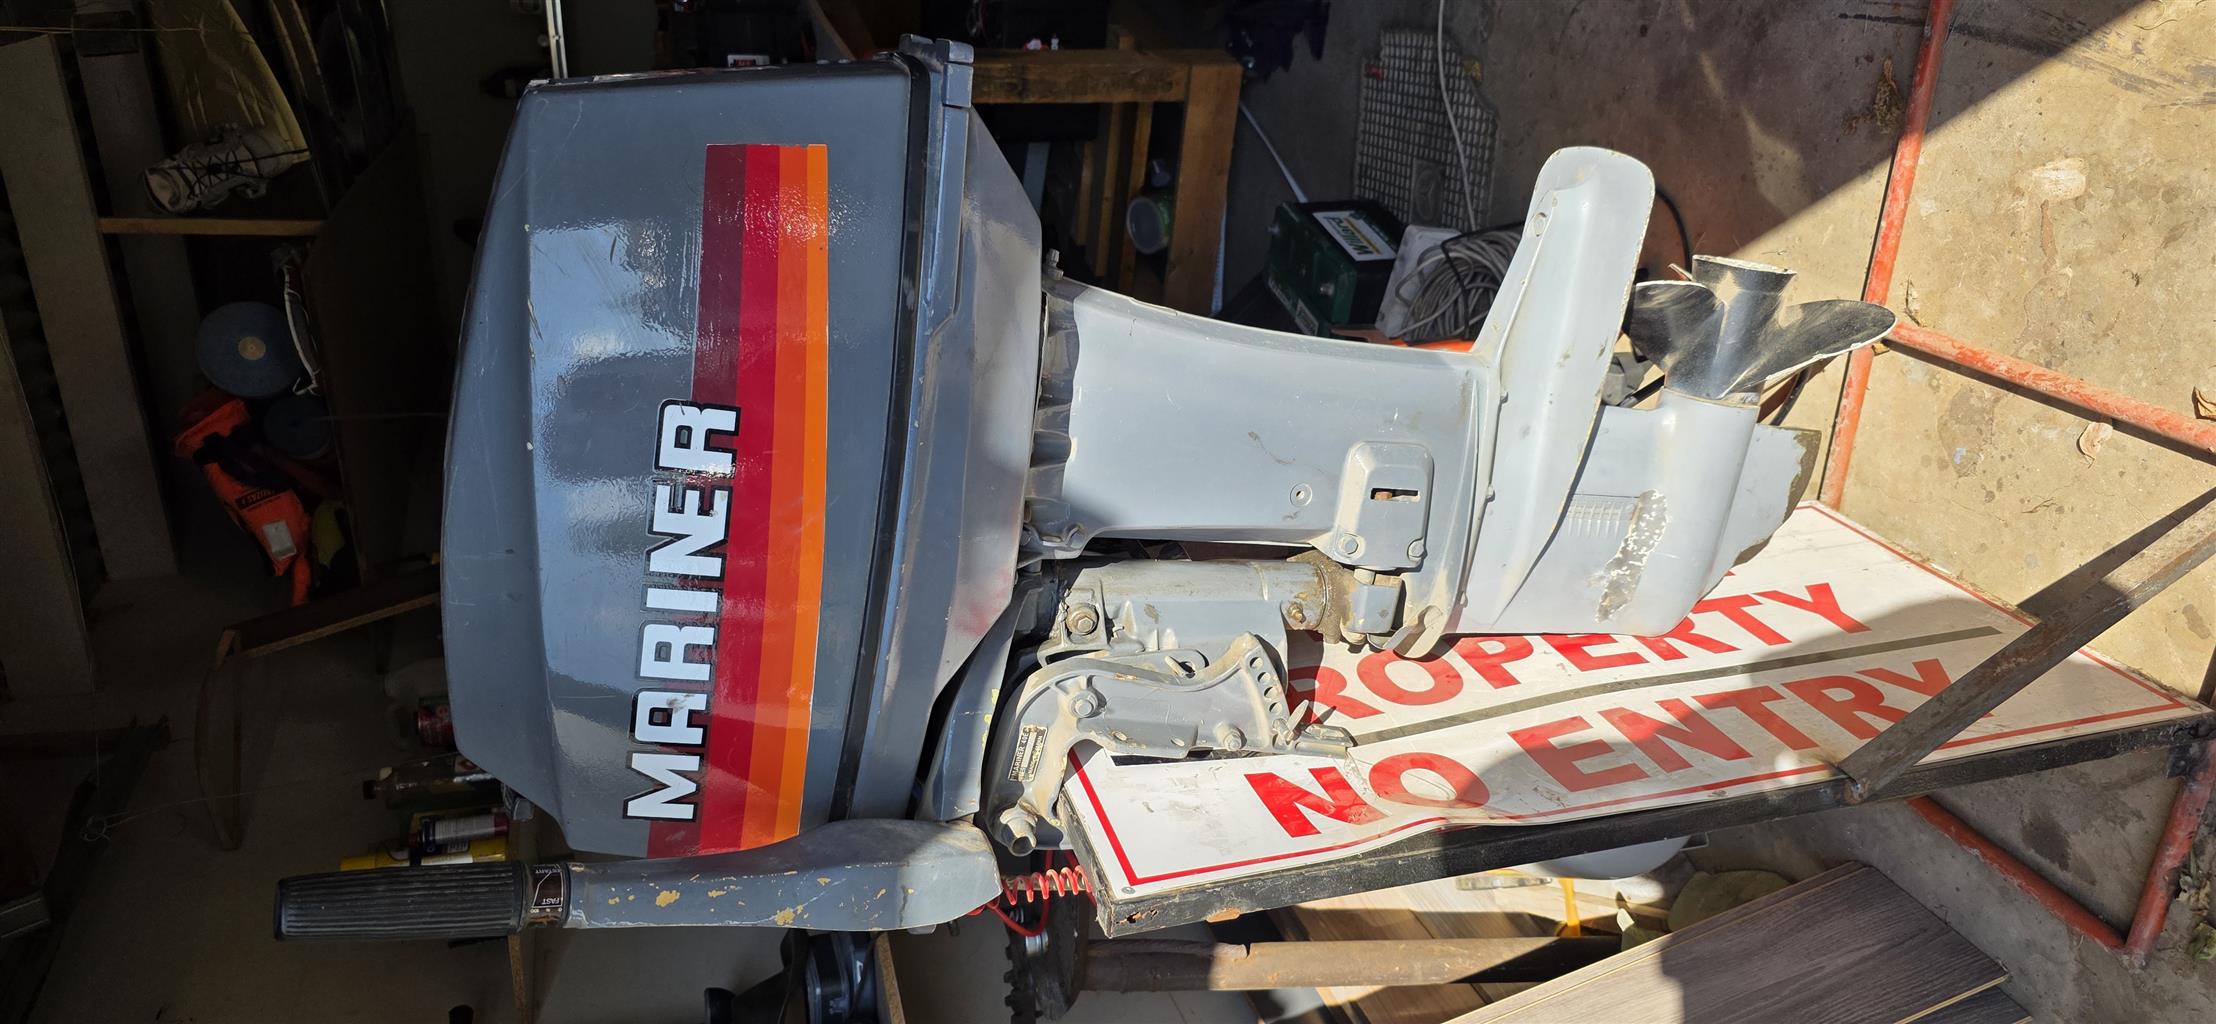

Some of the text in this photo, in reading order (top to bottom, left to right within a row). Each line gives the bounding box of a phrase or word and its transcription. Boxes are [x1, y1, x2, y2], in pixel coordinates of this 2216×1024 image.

[1322, 215, 1375, 255] Willard
[622, 398, 742, 821] MARINER
[1286, 582, 1873, 724] ROPERTY
[1011, 747, 1025, 777] MARINER
[1243, 658, 1994, 838] NO ENTRY
